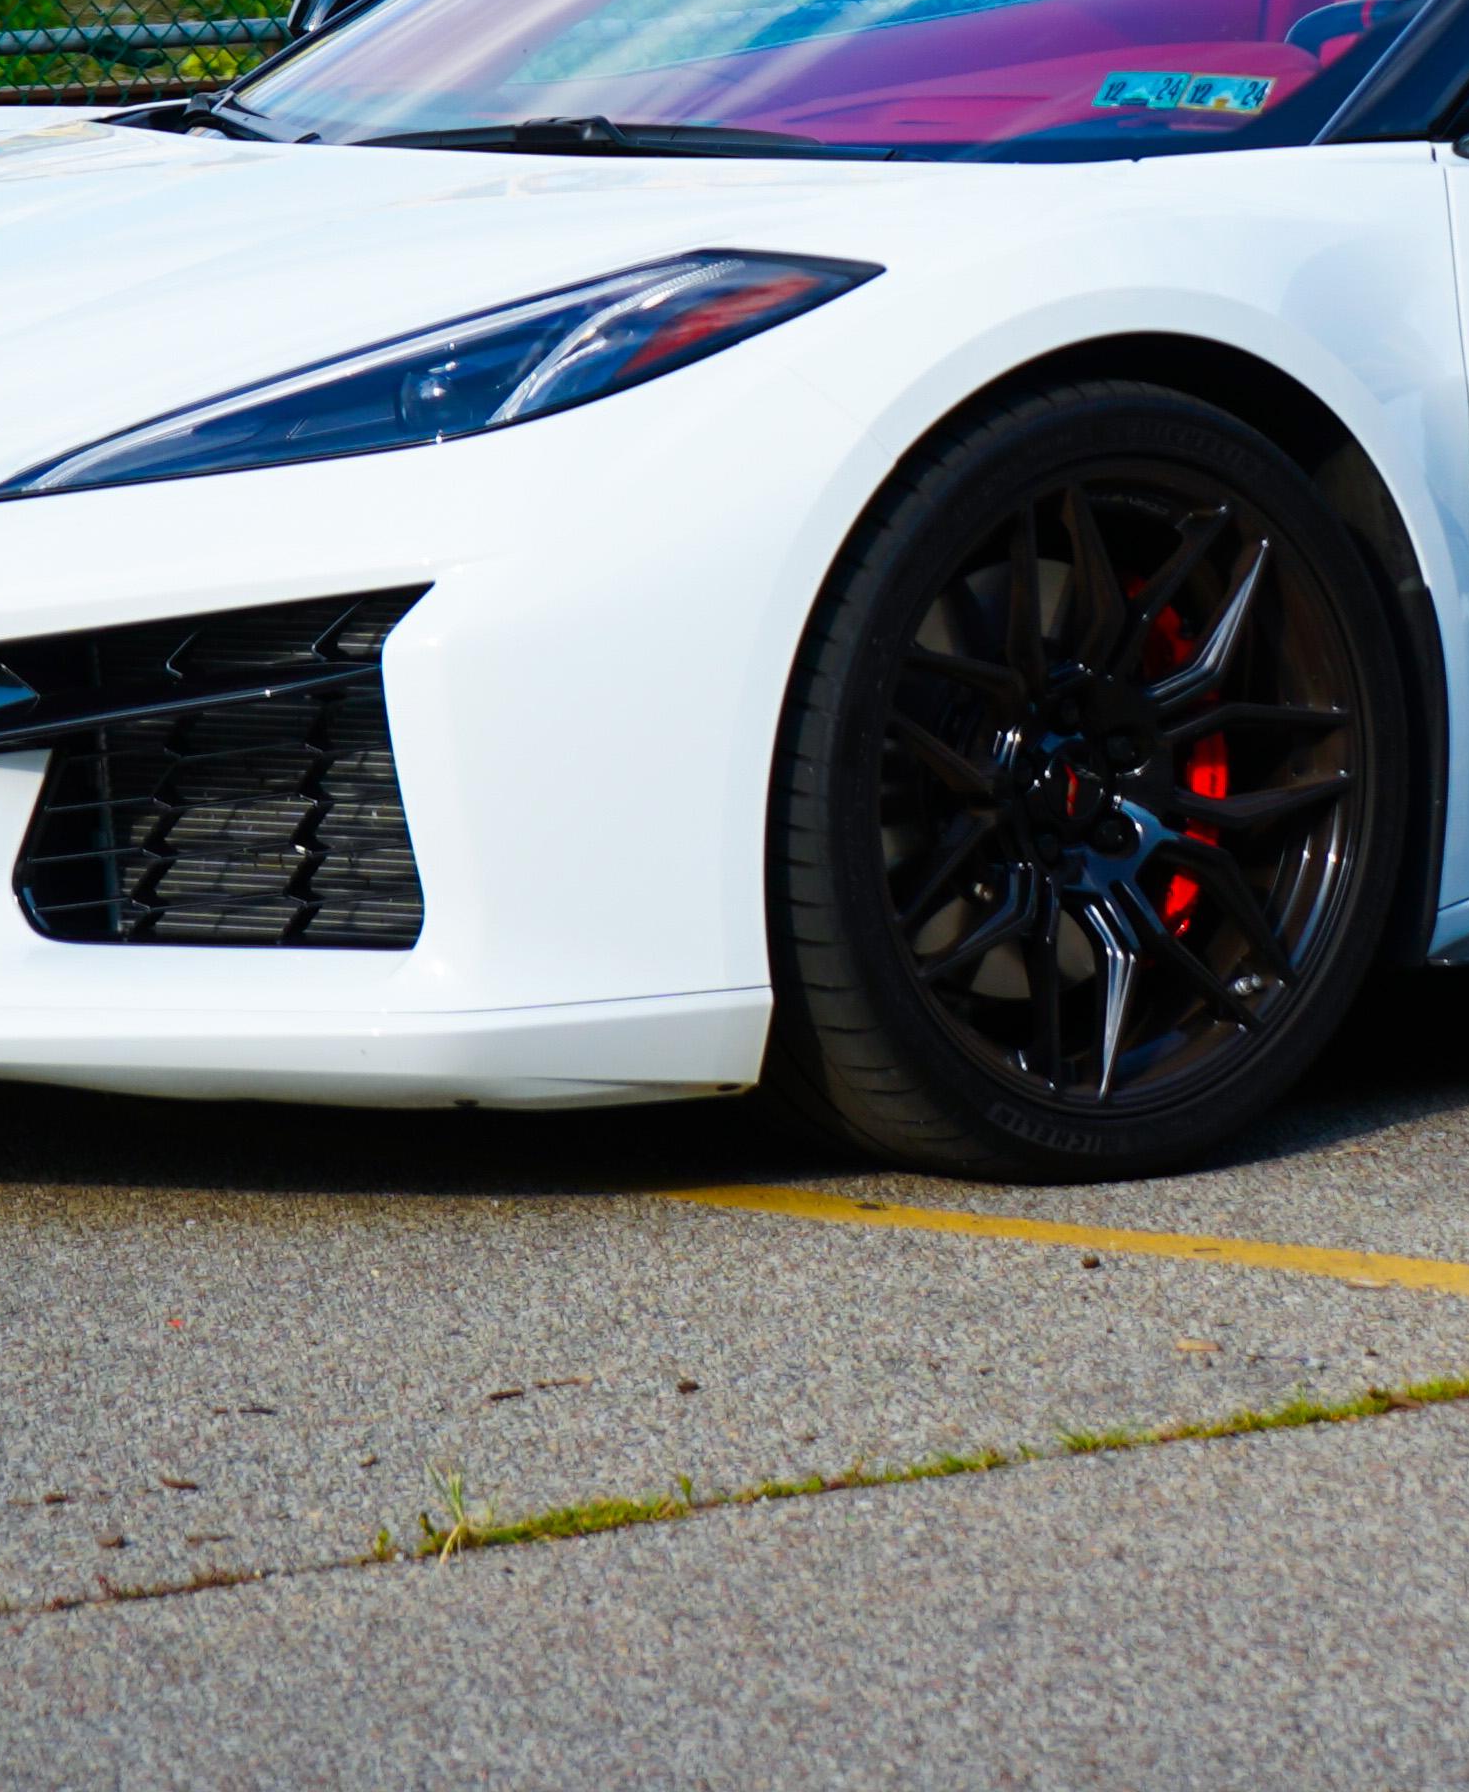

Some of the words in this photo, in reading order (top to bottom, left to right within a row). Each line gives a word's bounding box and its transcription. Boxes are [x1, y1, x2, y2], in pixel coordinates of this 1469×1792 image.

[1103, 81, 1127, 101] 12
[1156, 77, 1181, 101] 24
[1189, 83, 1214, 104] 12
[1241, 81, 1269, 106] 24
